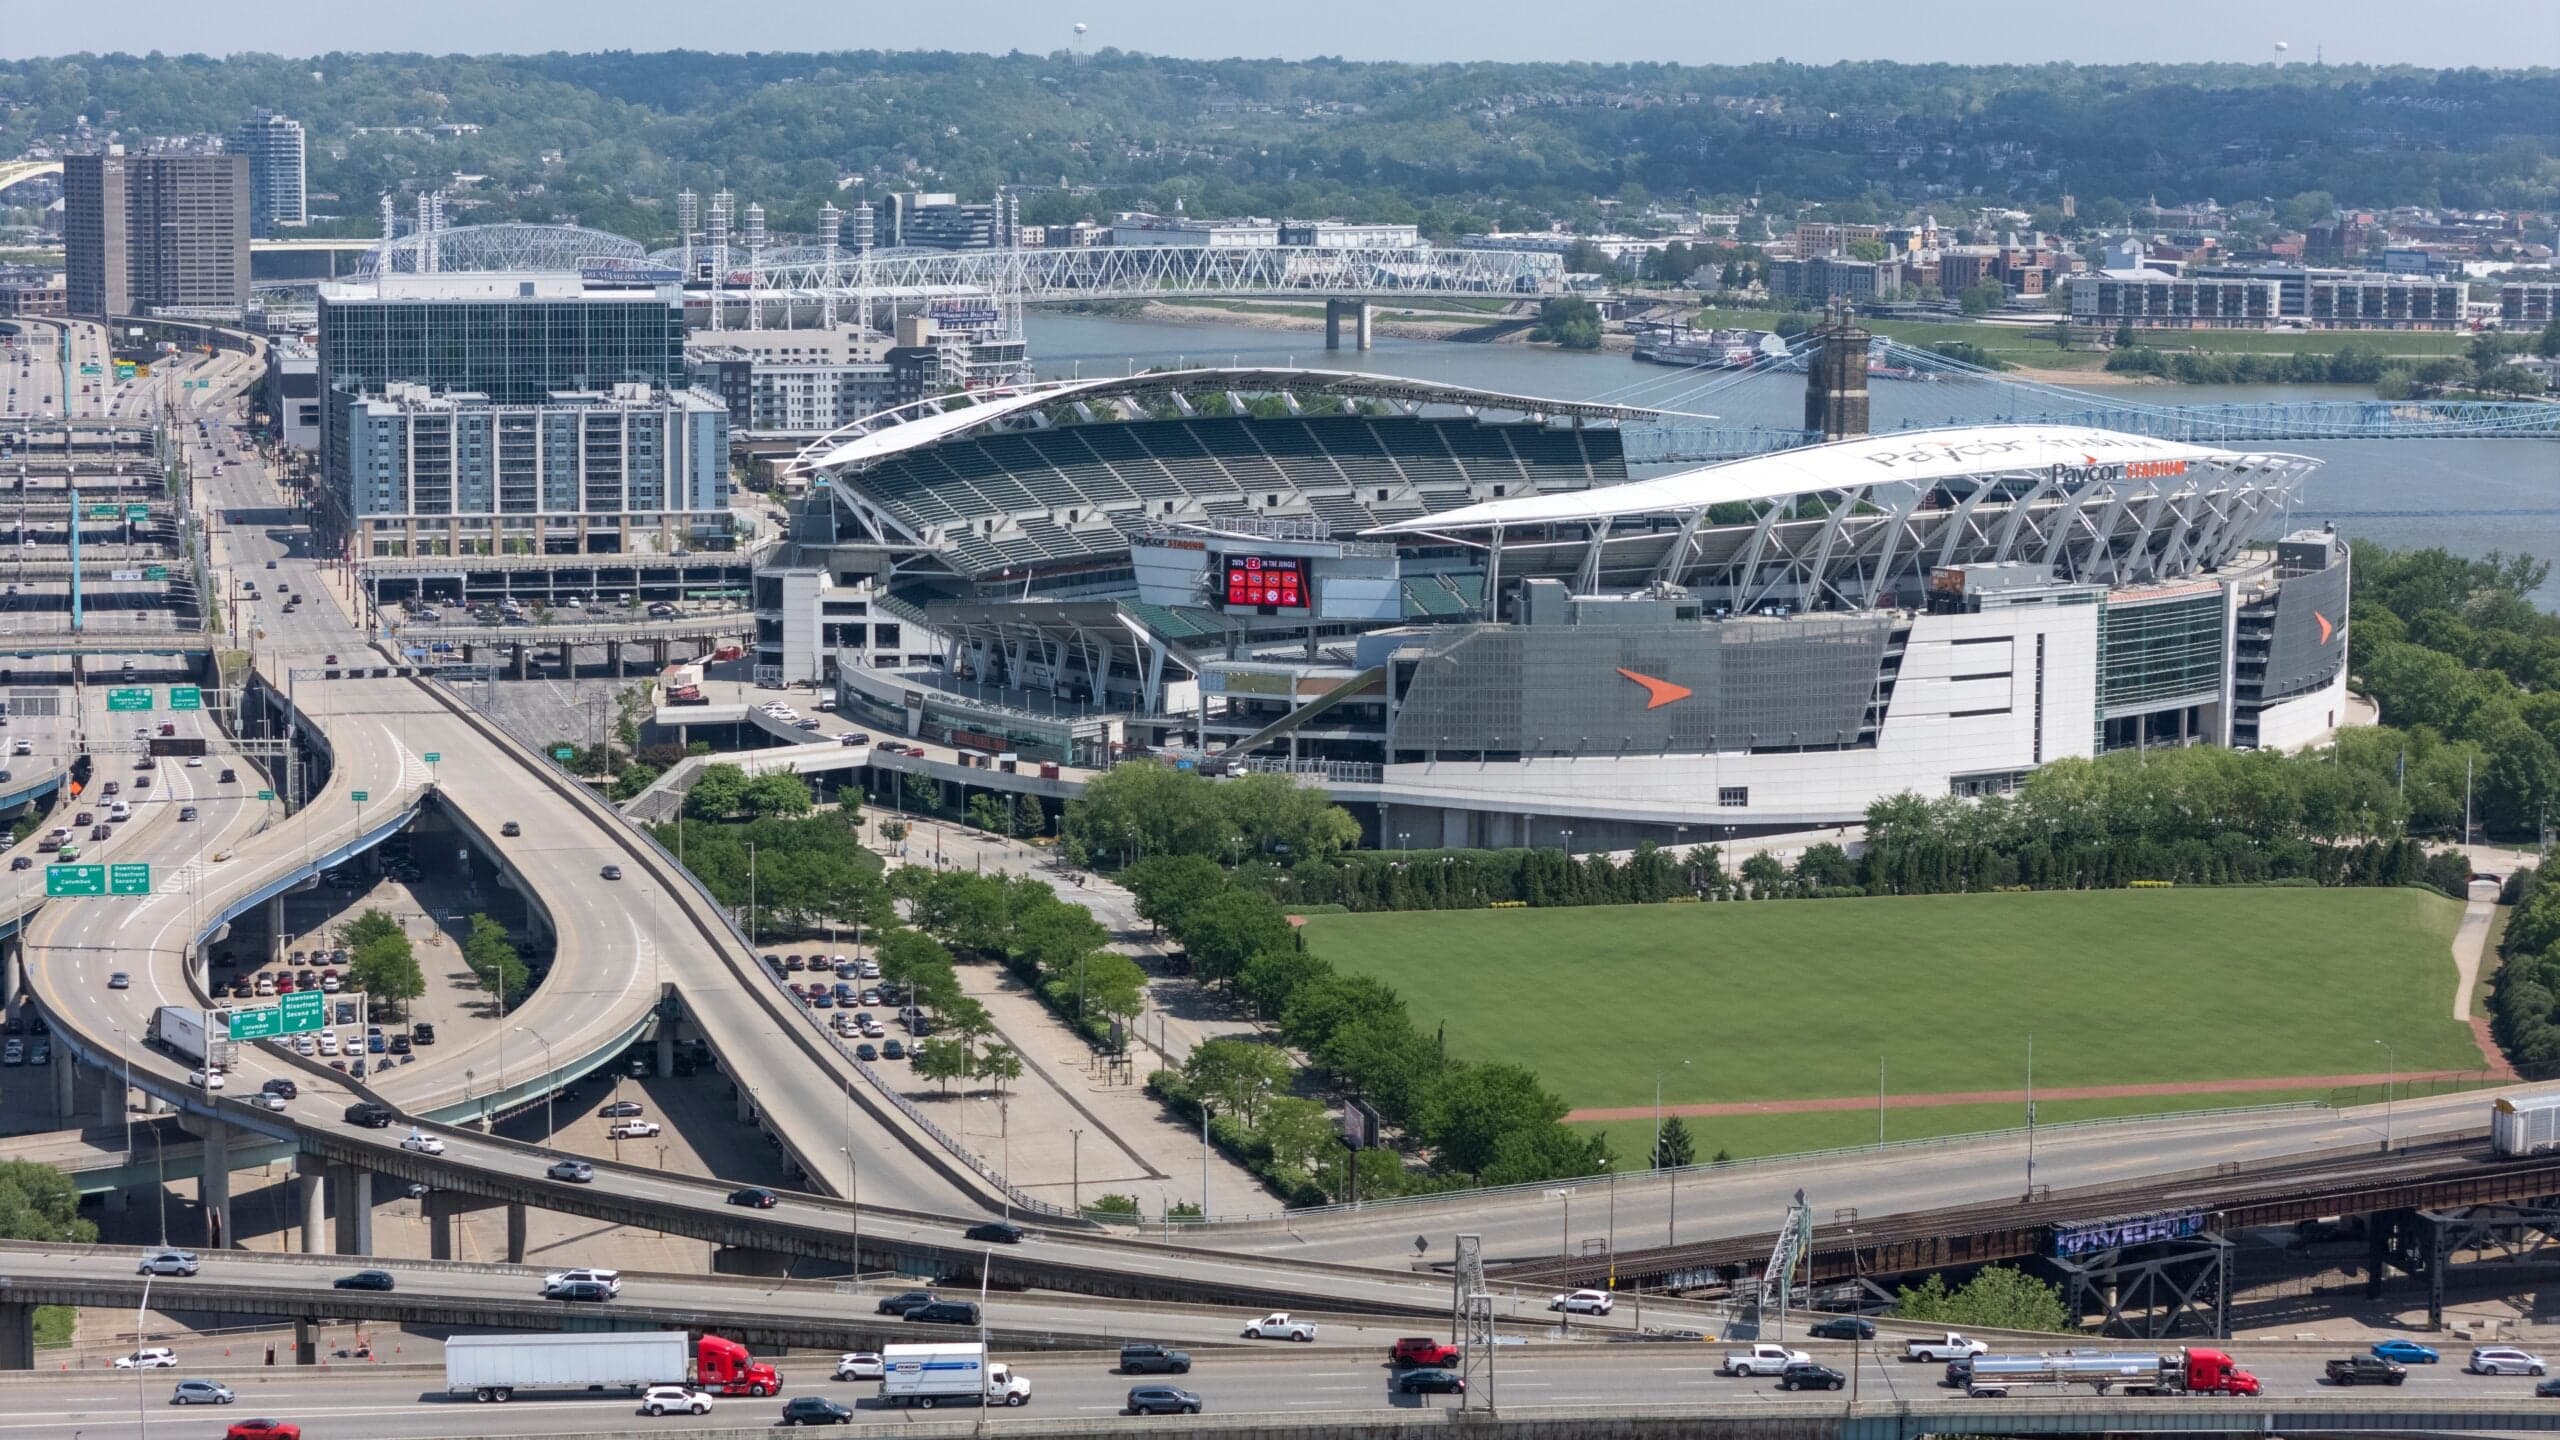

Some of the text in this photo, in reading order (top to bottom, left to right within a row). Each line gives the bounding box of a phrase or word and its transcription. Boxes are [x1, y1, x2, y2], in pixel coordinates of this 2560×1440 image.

[1865, 439, 2024, 467] Paycor
[2052, 460, 2185, 484] Paycor STADIUM
[1128, 532, 1167, 547] Paycor
[1278, 560, 1296, 568] JUNGLE
